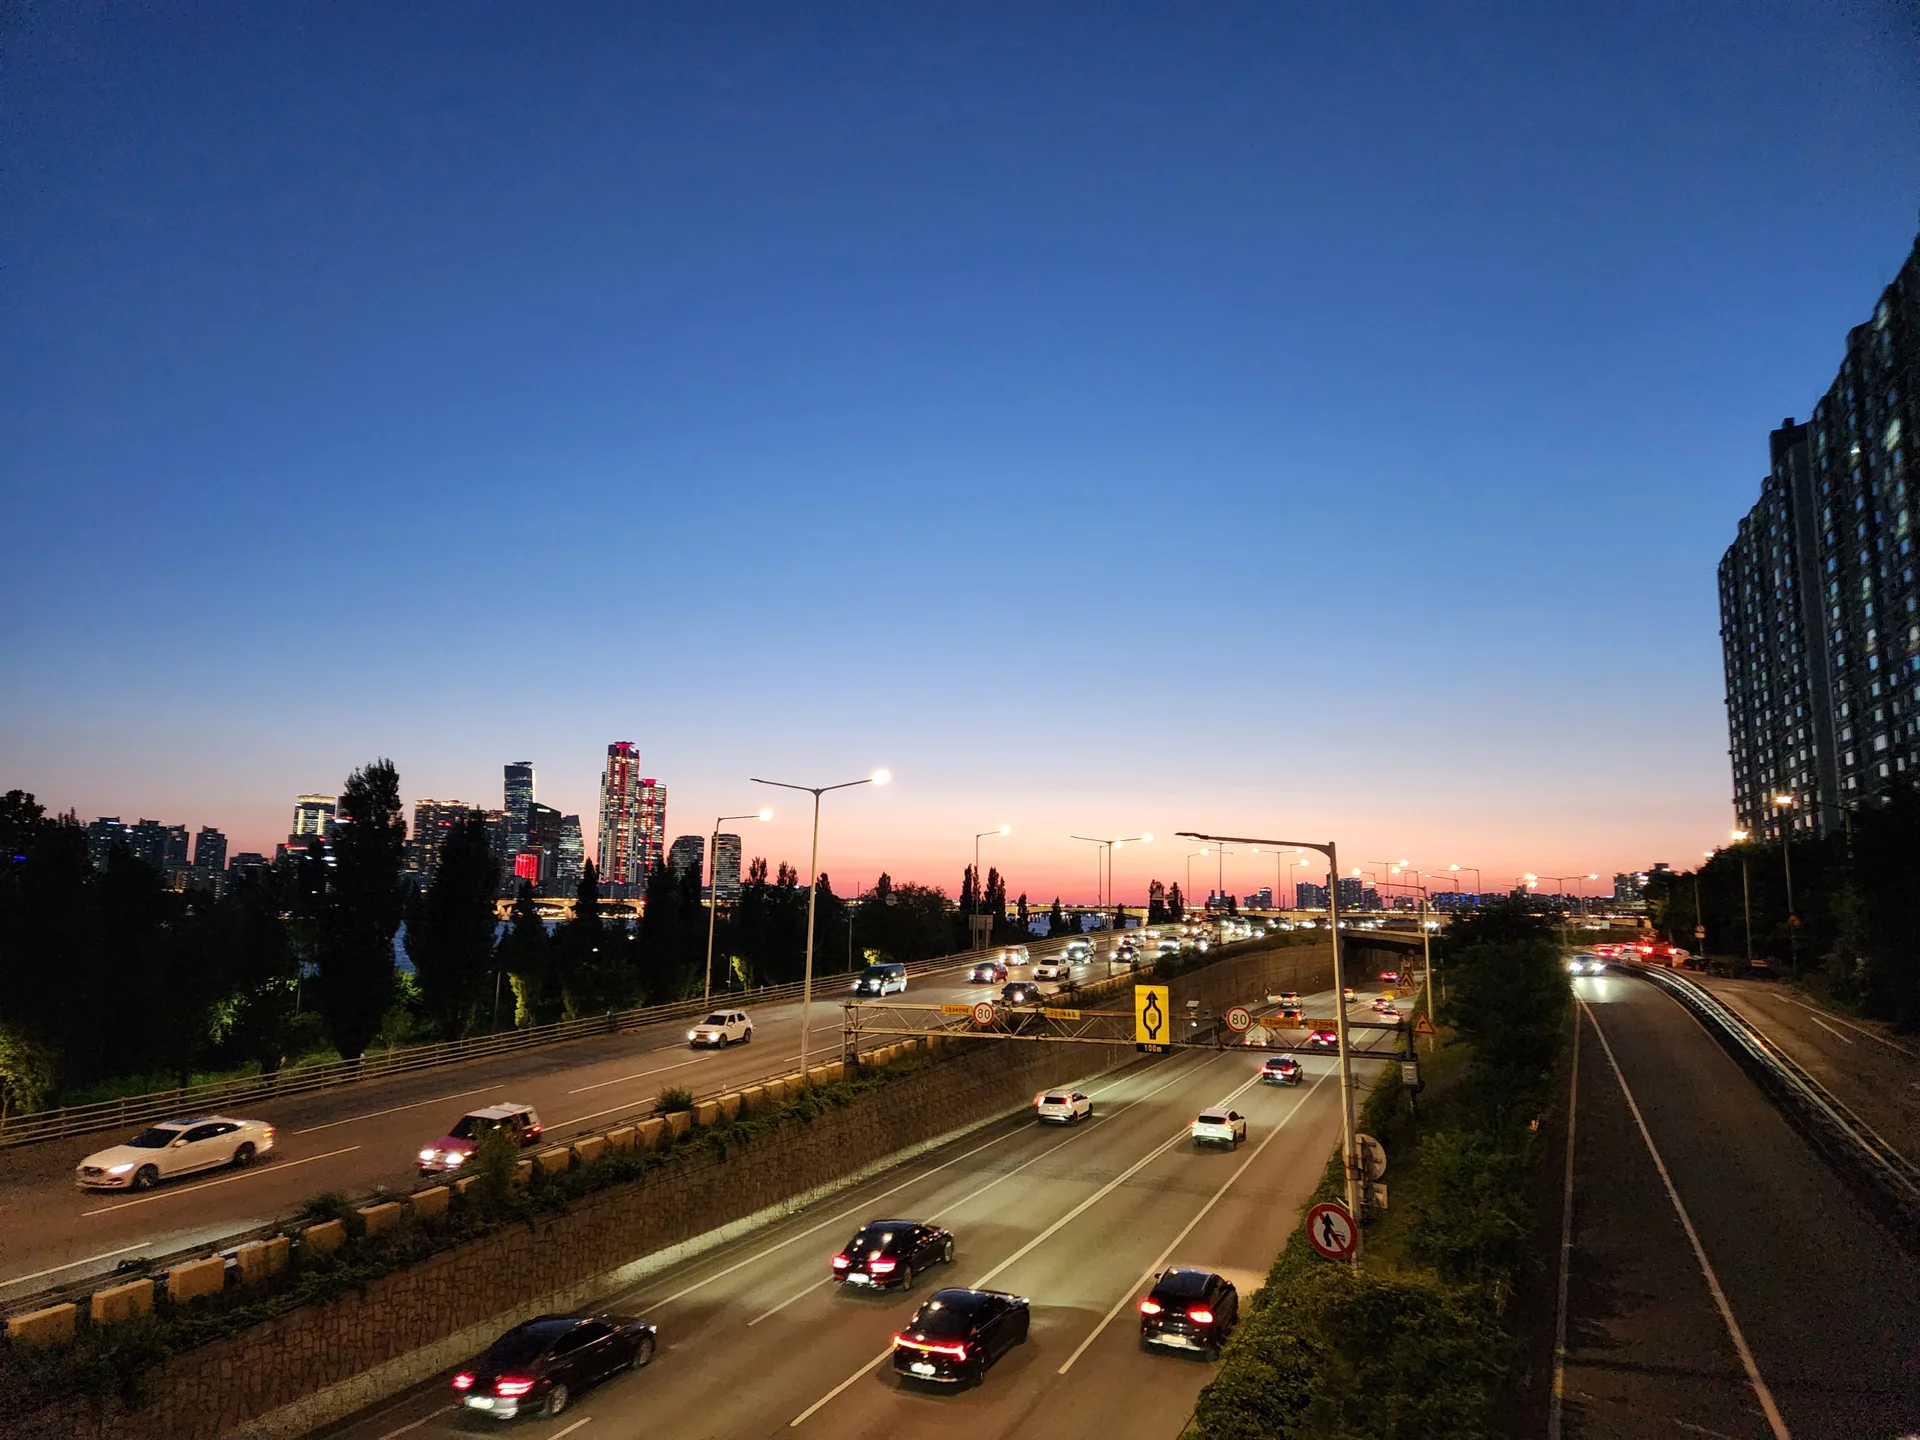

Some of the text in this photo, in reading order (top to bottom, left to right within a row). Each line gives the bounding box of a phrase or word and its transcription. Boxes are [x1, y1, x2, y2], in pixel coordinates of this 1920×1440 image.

[977, 1008, 991, 1019] 80
[1231, 1013, 1247, 1025] 80
[1144, 1044, 1163, 1052] 100m
